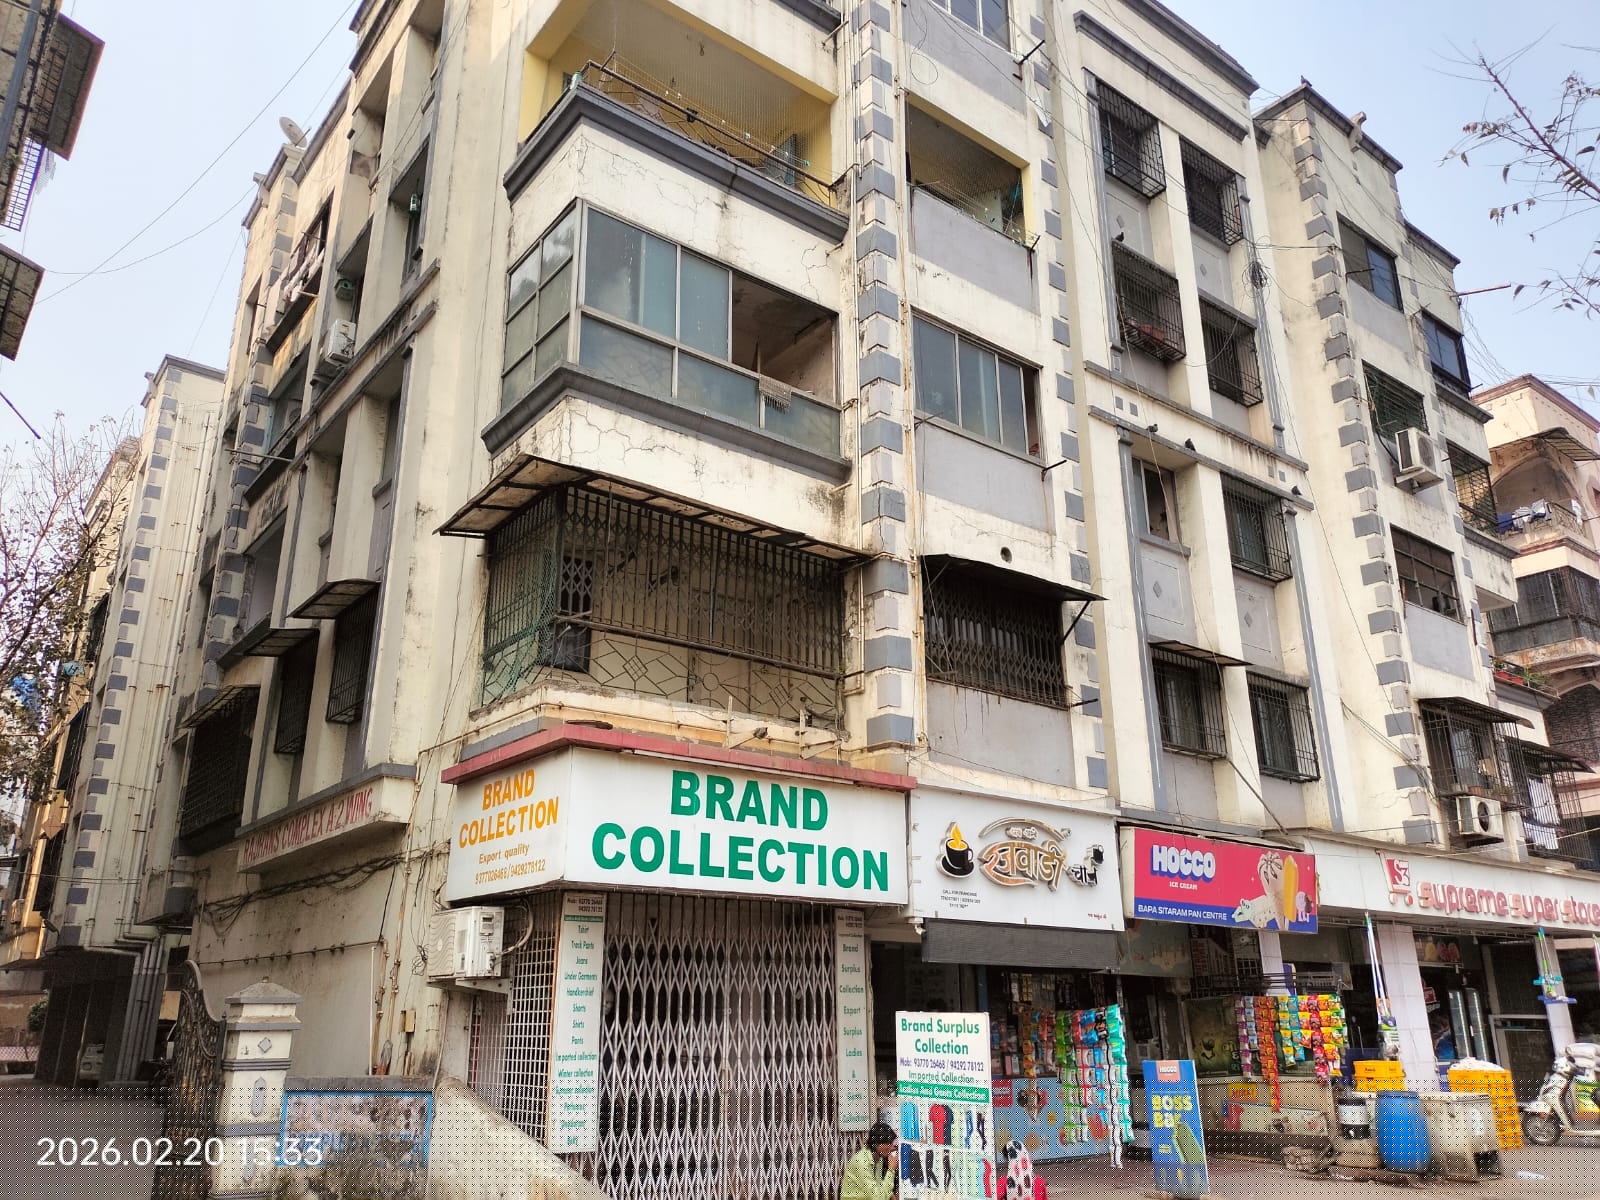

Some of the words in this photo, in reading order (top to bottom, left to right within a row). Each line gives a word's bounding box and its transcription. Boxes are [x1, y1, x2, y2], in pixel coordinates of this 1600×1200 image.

[482, 769, 535, 811] BRAND
[670, 769, 828, 831] BRAND
[281, 807, 326, 849] COMPLEX
[345, 787, 372, 824] WING
[459, 796, 559, 849] COLLECTION
[478, 850, 501, 865] Export
[504, 843, 530, 860] quality
[591, 822, 889, 891] COLLECTION
[1151, 844, 1216, 882] HOCCO
[1137, 904, 1157, 914] BAPA
[1158, 906, 1188, 917] SITARAM
[1188, 909, 1202, 918] PAN
[1202, 911, 1228, 921] CENTRE
[901, 1017, 933, 1033] Brand
[936, 1018, 980, 1038] Surplus
[914, 1037, 969, 1055] Collection
[908, 1069, 940, 1081] Imported
[940, 1072, 975, 1084] Collection
